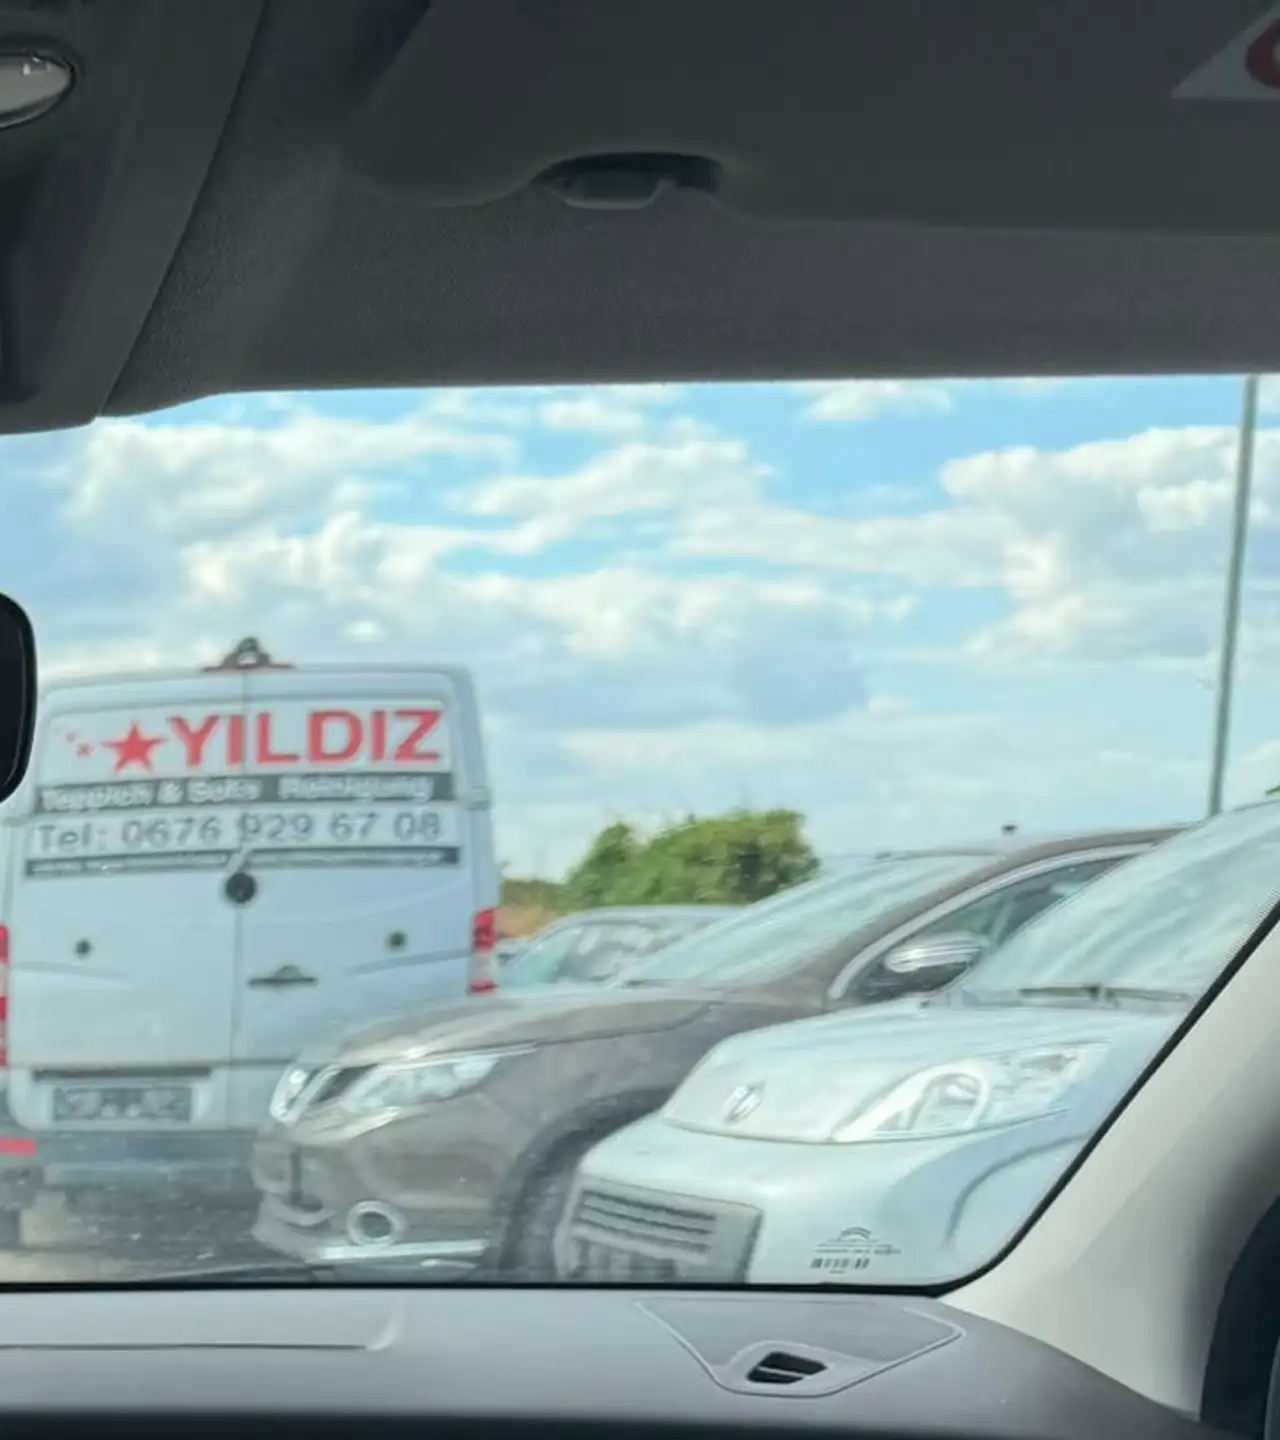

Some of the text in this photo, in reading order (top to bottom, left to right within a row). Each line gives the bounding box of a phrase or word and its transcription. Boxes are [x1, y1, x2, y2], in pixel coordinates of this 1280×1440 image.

[167, 709, 442, 768] YILDIZ
[38, 822, 108, 850] Tel:
[122, 815, 223, 850] 0676
[329, 811, 379, 842] 67
[393, 810, 441, 842] 08
